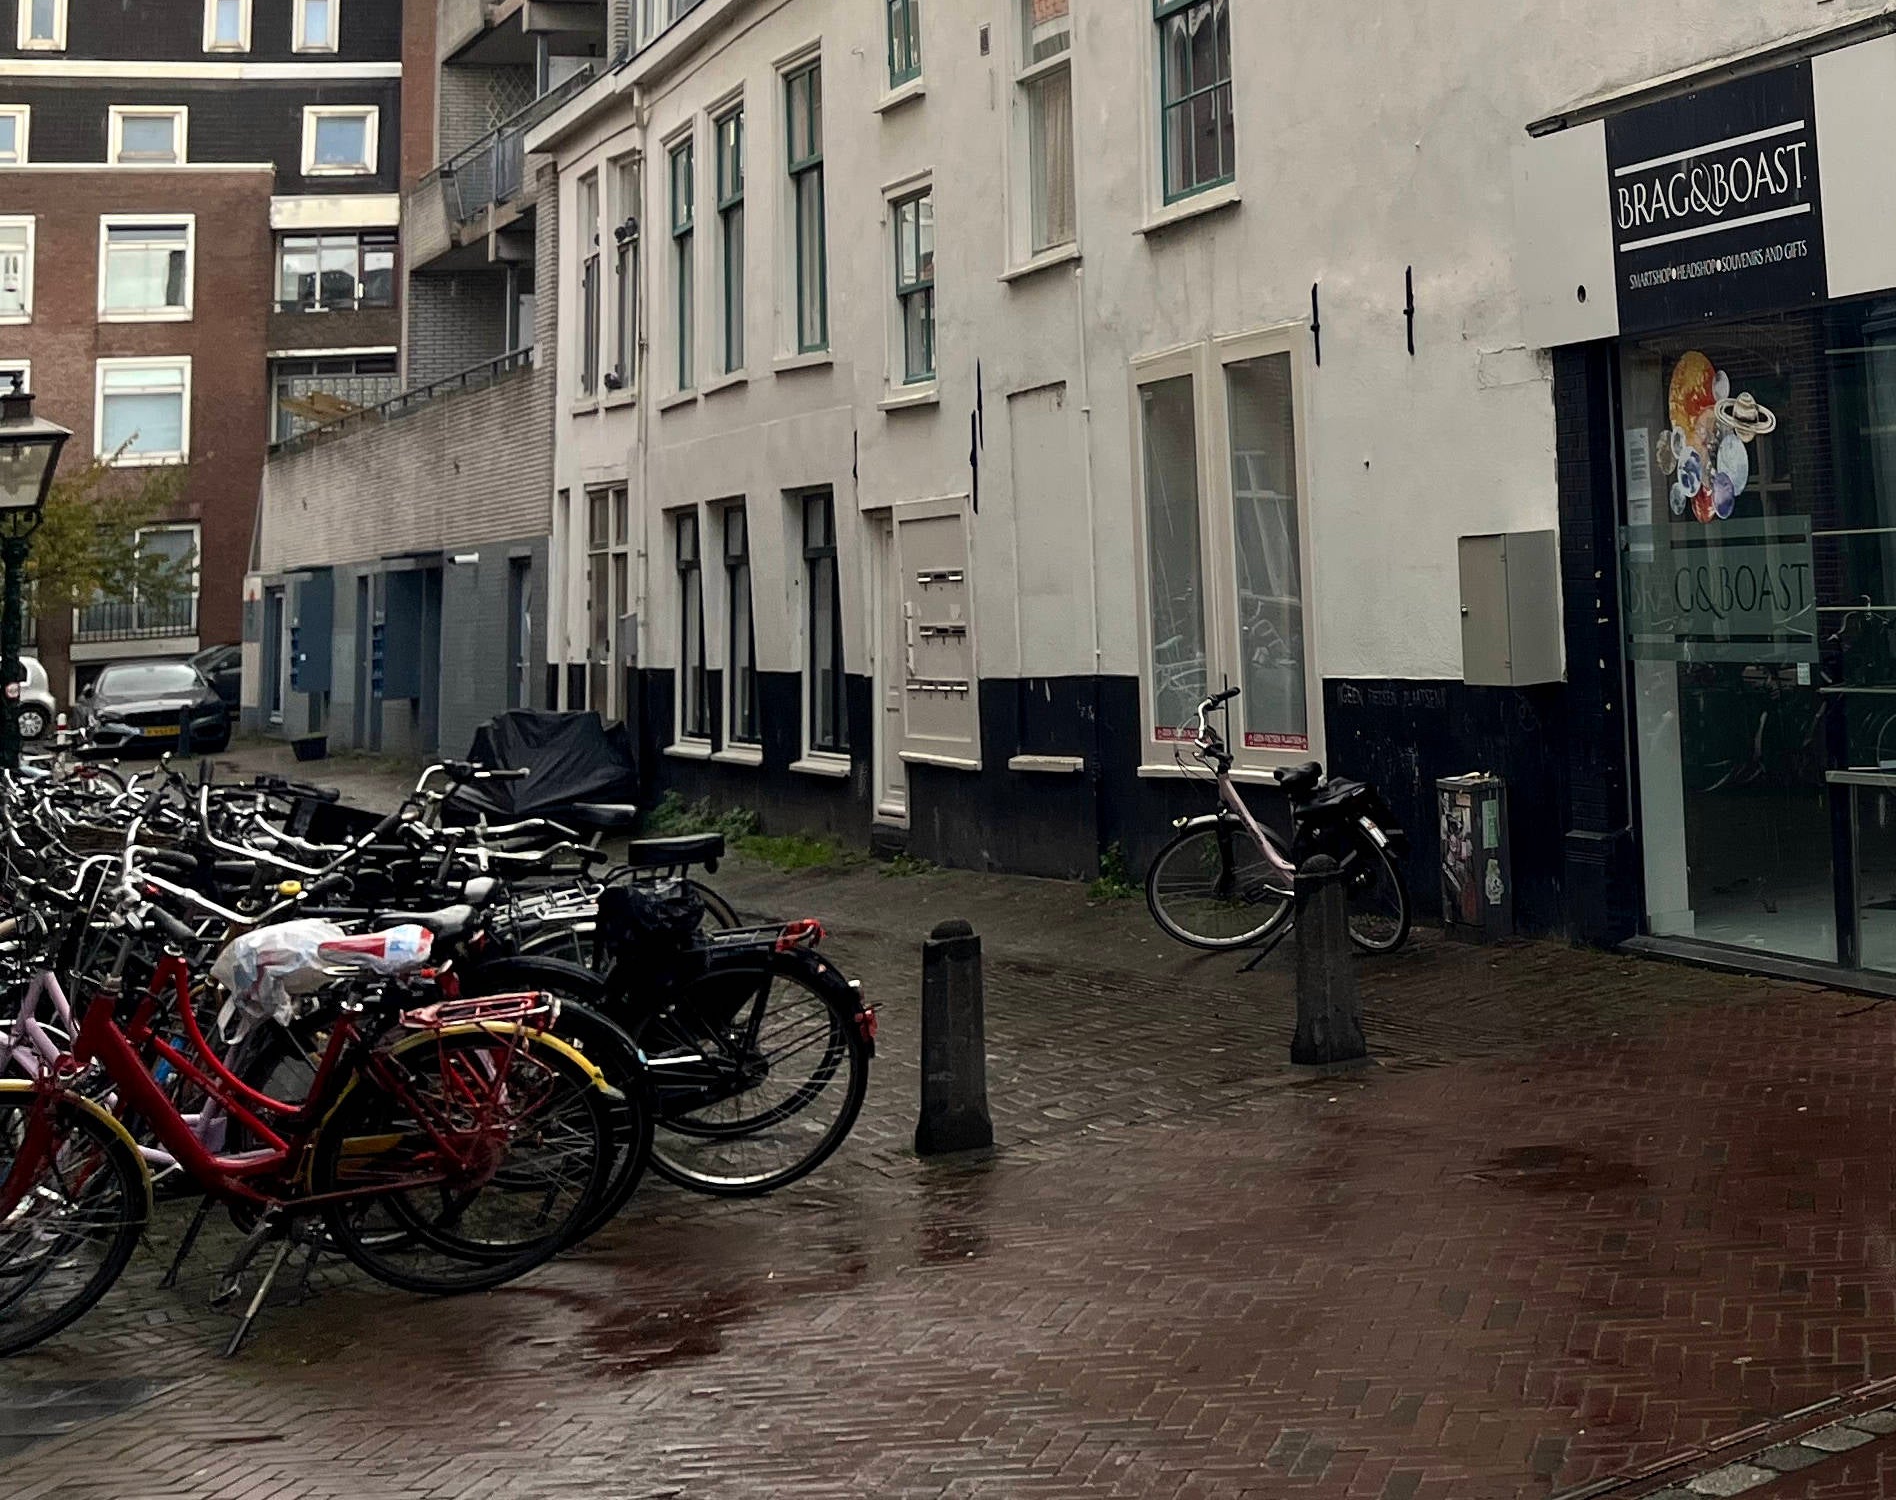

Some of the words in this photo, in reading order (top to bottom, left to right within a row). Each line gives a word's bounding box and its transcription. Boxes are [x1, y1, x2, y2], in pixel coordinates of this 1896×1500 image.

[1617, 142, 1807, 230] BRAG&BOAST
[1764, 245, 1783, 263] AND
[1784, 240, 1808, 260] GIFTS
